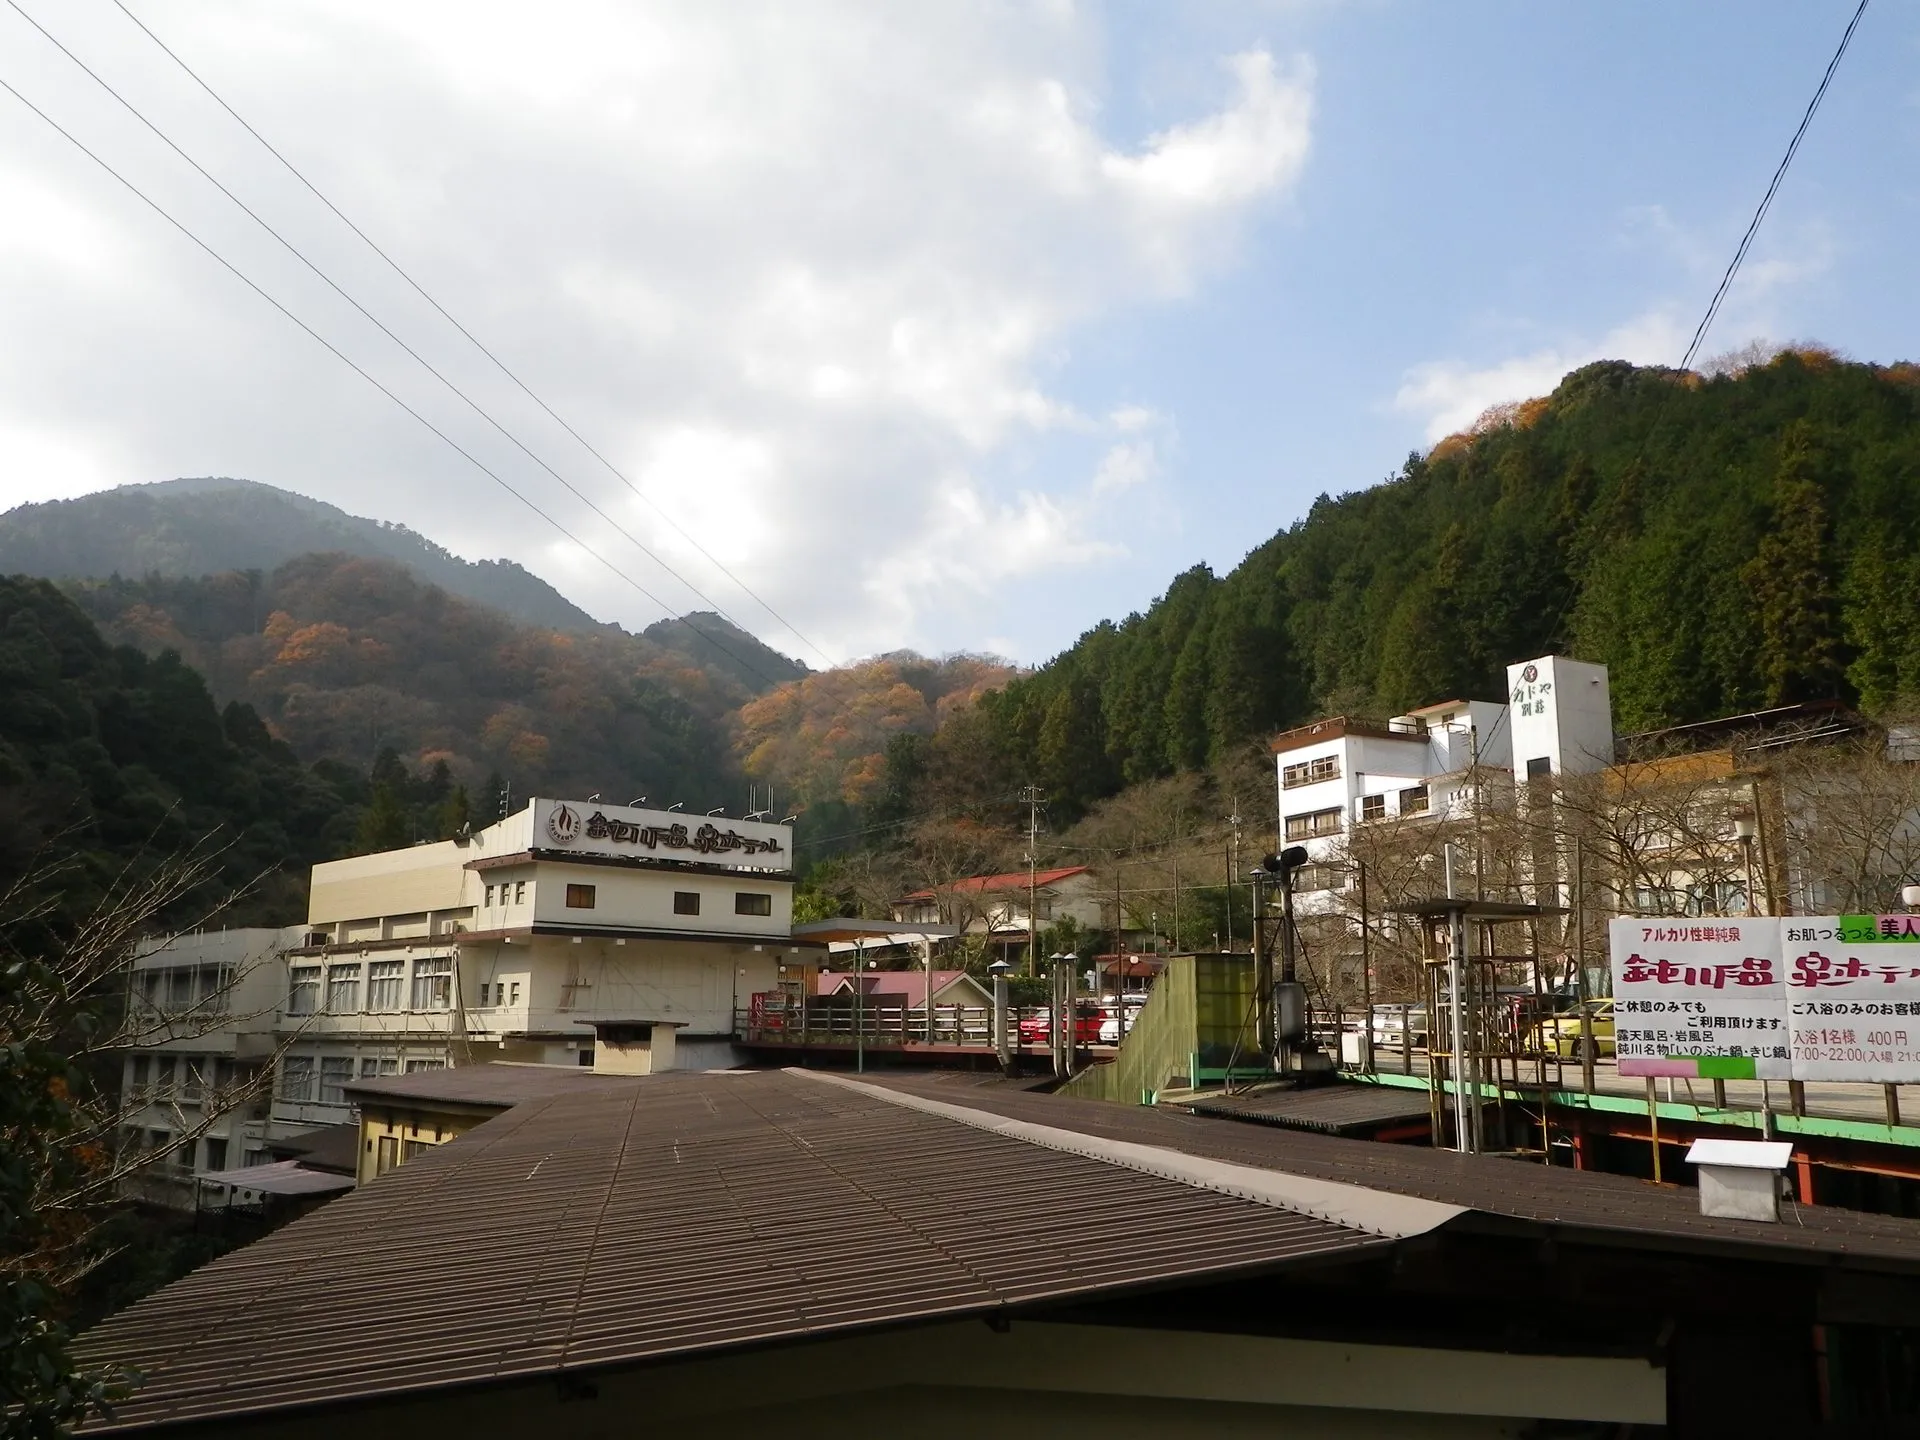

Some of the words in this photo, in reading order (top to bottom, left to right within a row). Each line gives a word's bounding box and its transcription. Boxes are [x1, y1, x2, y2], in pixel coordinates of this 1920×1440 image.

[1641, 926, 1741, 943] アルカリ性単純泉
[1614, 1000, 1706, 1013] ご休憩のみでも
